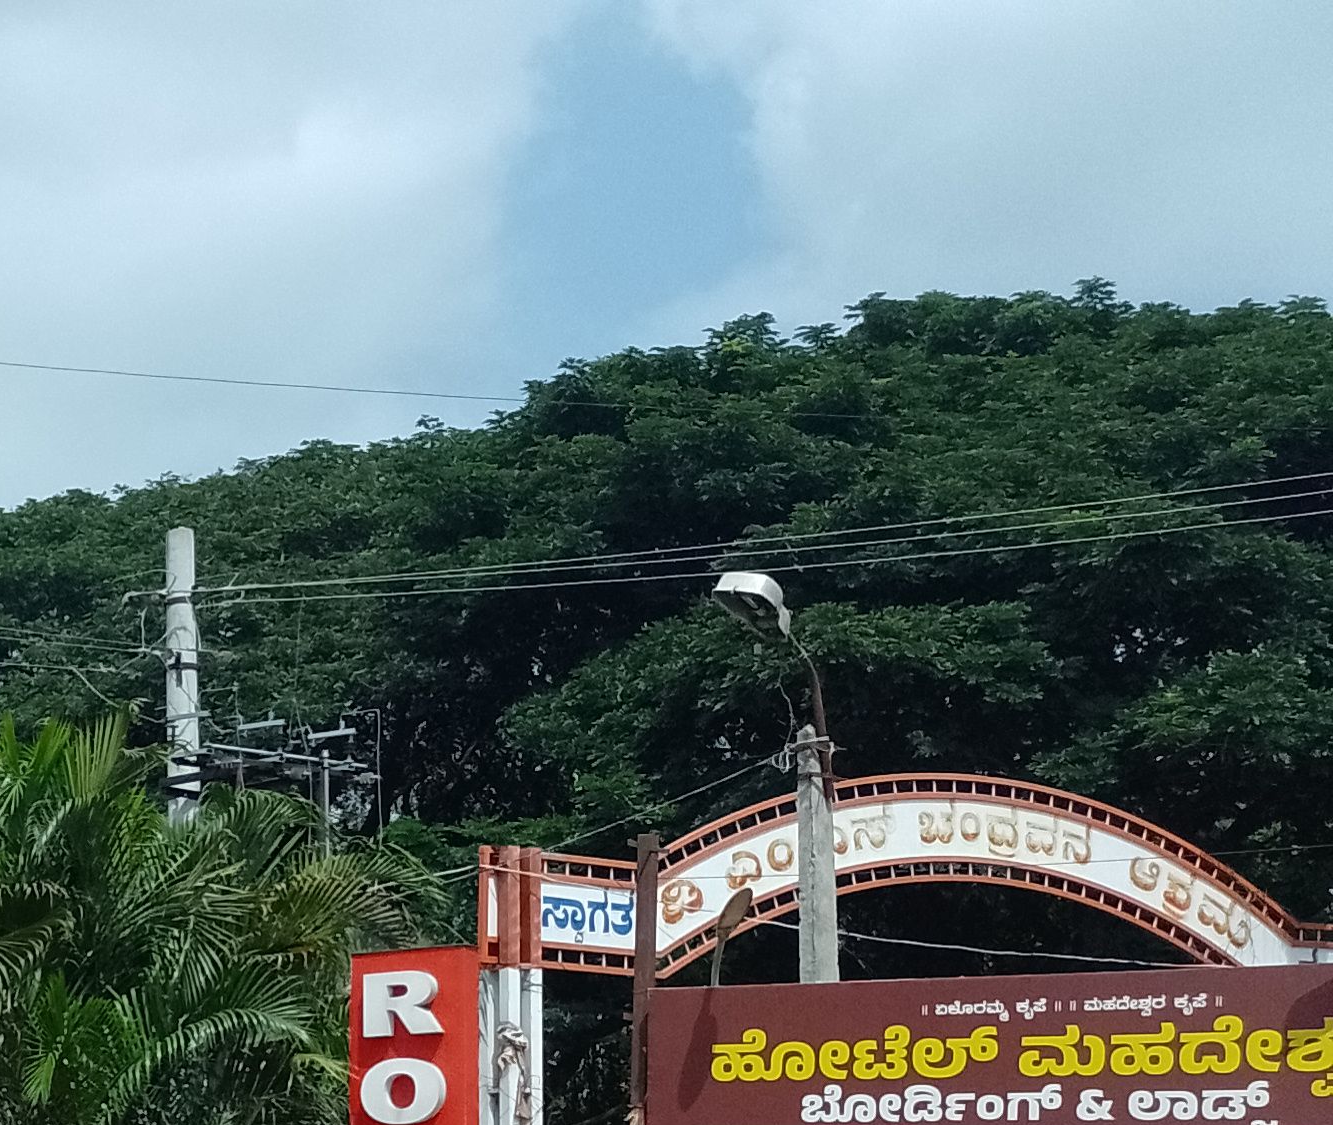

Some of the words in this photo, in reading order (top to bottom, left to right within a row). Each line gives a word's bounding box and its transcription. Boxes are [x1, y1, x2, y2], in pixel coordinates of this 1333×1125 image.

[541, 886, 635, 944] ಸ್ವಾಗತ
[1083, 993, 1167, 1017] ಮಹದೇಶ್ವರ
[710, 1024, 999, 1082] ಹೋಟೆಲ್
[800, 1083, 1063, 1123] ಬೋರ್ಡಿಂಗ್
[1075, 1088, 1115, 1122] &
